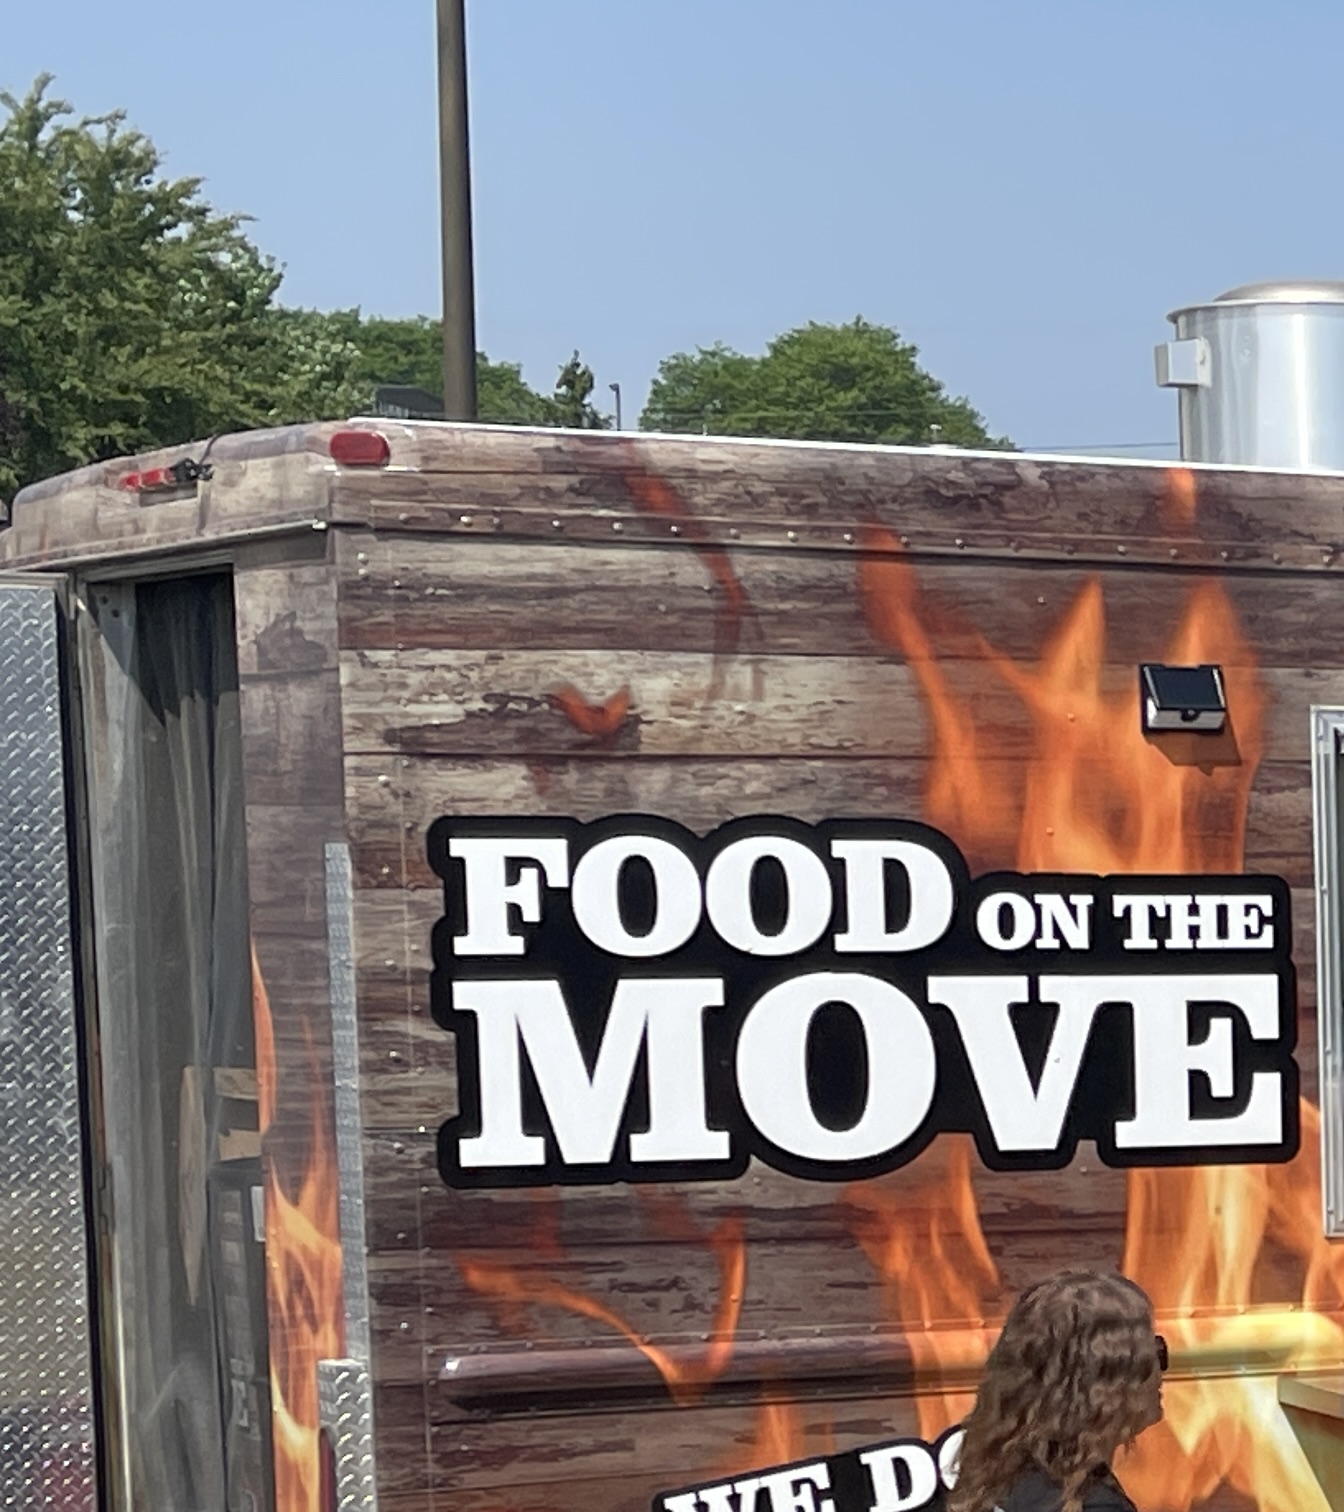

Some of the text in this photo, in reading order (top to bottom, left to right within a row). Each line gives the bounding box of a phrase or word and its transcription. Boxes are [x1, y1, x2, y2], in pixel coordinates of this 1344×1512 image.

[448, 834, 1276, 957] FOOD ON THE
[451, 971, 1284, 1168] MOVE
